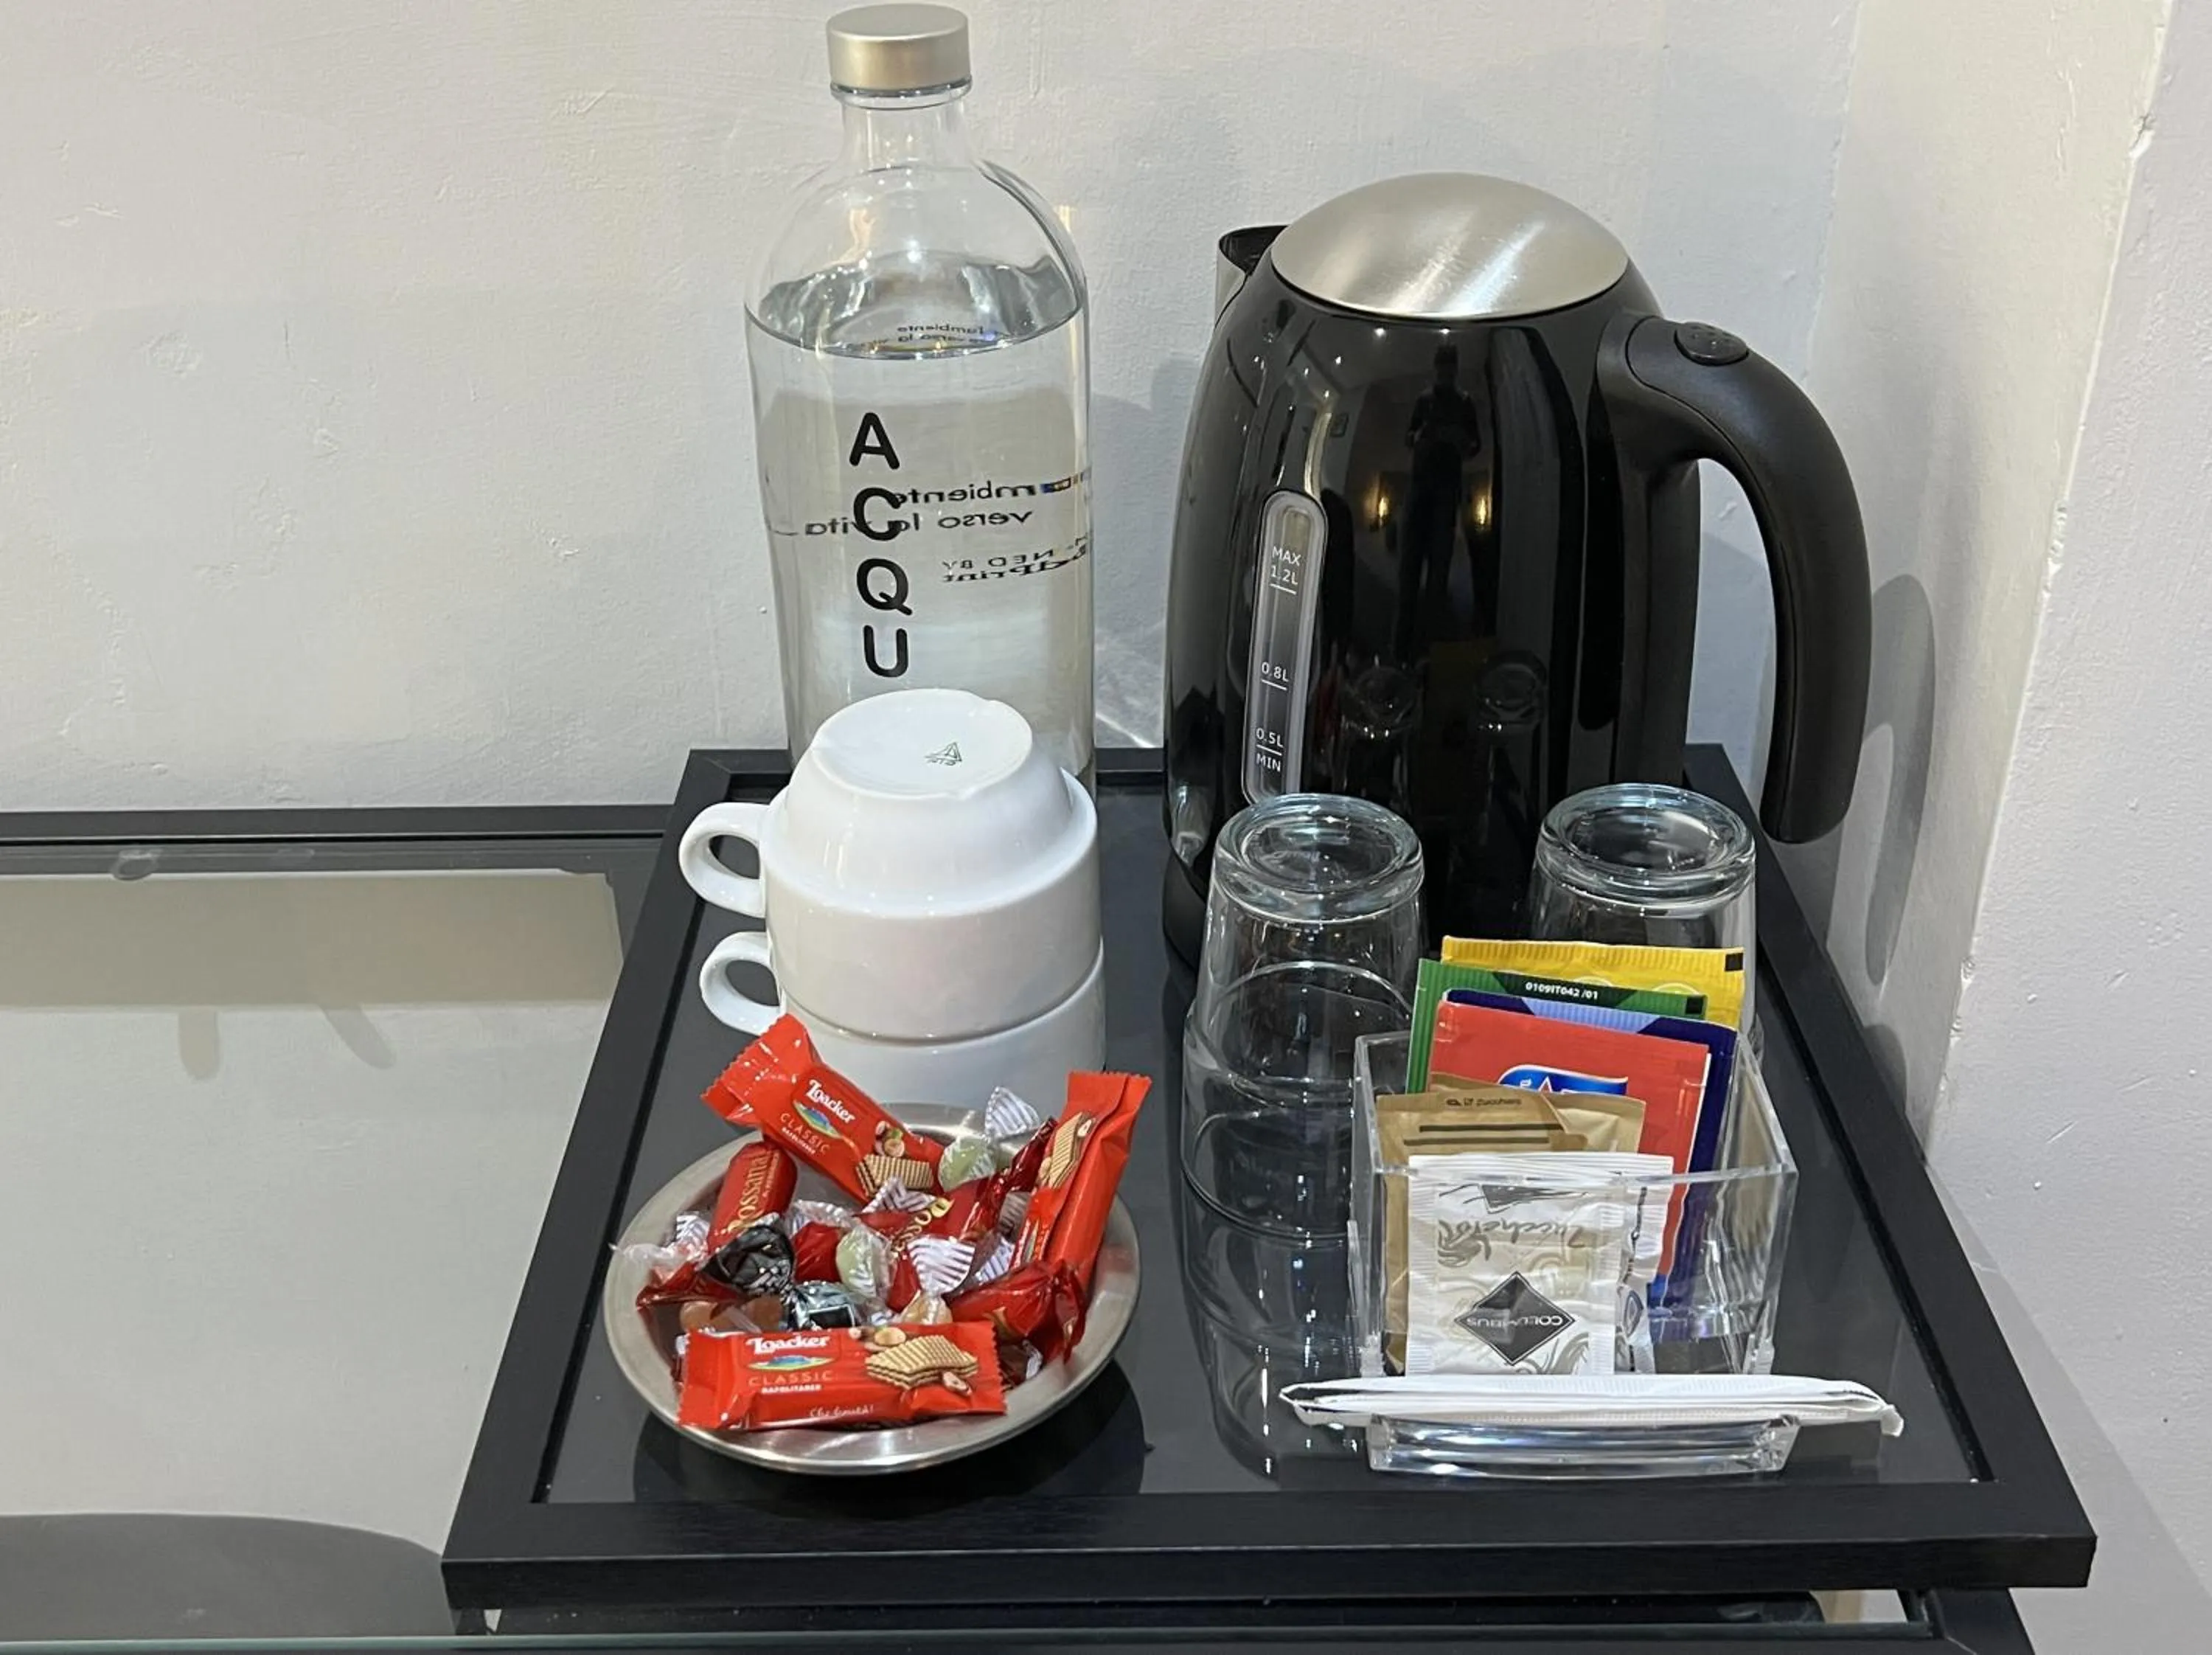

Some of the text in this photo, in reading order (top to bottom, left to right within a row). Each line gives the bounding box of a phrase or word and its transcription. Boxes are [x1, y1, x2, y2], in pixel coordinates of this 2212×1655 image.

[1271, 546, 1301, 566] MAX
[1270, 566, 1298, 586] 1.2L
[1261, 662, 1290, 682] 0.8L
[1256, 727, 1284, 748] 0.5L
[1256, 753, 1281, 772] MIN
[1525, 982, 1580, 997] 0109IT042
[806, 1078, 856, 1124] Loacker
[780, 1112, 832, 1155] CLASSIC
[1467, 1314, 1564, 1328] COLUMBUS
[745, 1334, 831, 1355] Loacker
[748, 1370, 834, 1386] CLASSIC
